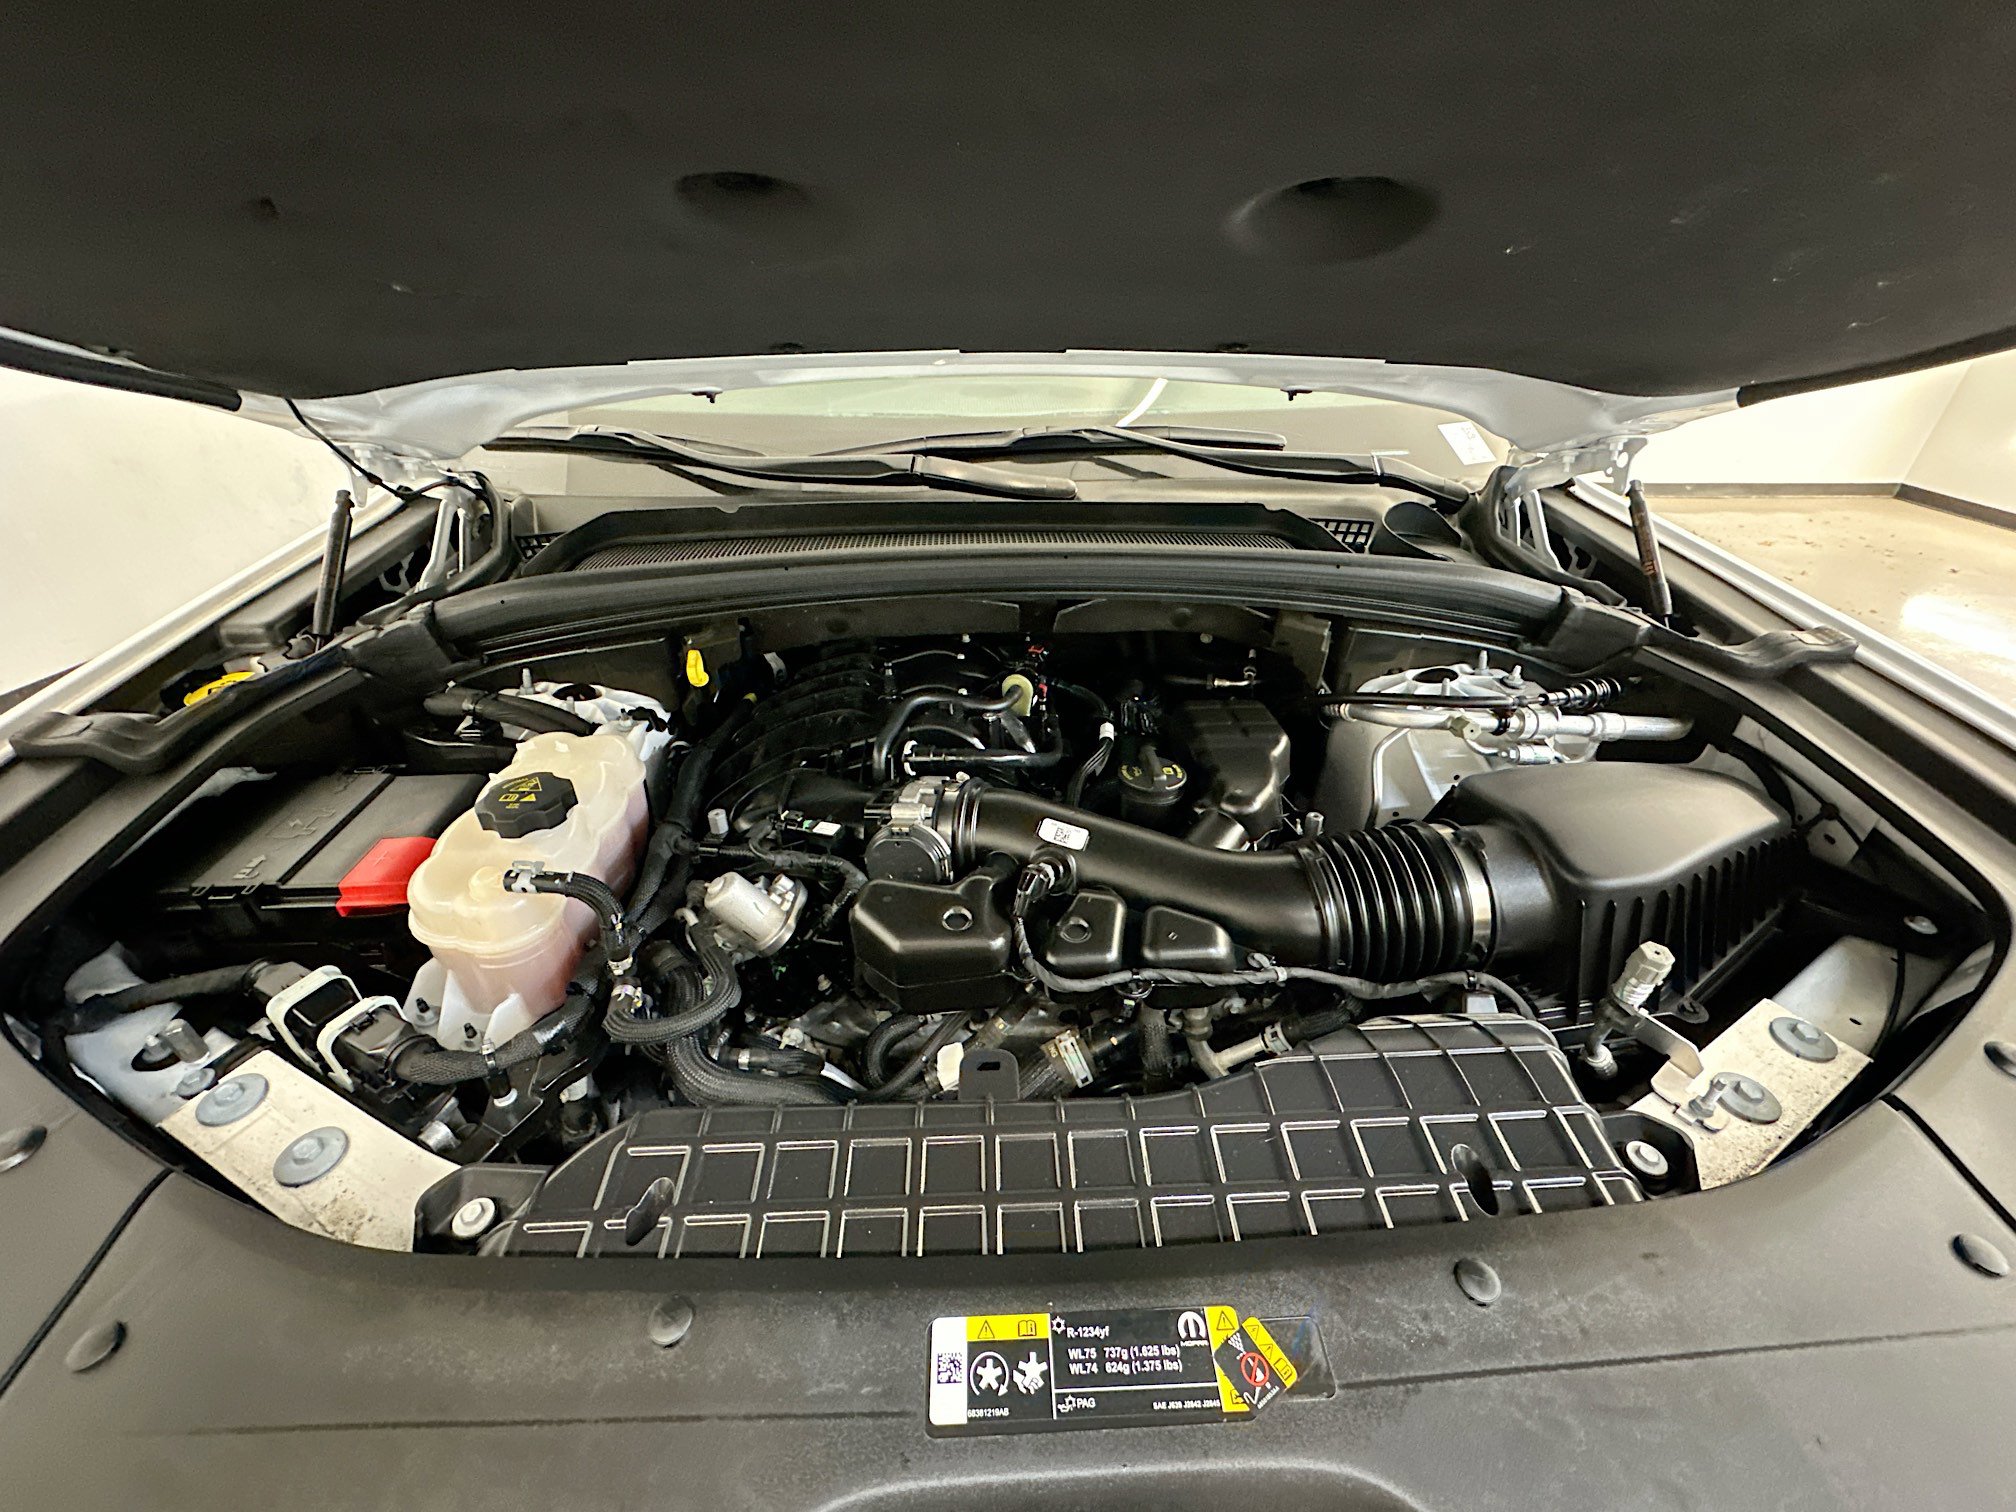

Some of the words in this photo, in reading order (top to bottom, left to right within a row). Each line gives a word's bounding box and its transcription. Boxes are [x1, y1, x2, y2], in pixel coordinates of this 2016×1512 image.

[1066, 1326, 1109, 1339] R-1234yf
[1068, 1347, 1097, 1360] WL75
[1104, 1346, 1128, 1359] 737g
[1130, 1346, 1160, 1359] (1.625
[1162, 1344, 1180, 1357] lbs)
[1069, 1362, 1098, 1375] WL74
[1105, 1361, 1129, 1375] 624g
[1132, 1360, 1161, 1374] (1.375
[1163, 1359, 1183, 1372] lbs)
[1076, 1397, 1096, 1408] PAG
